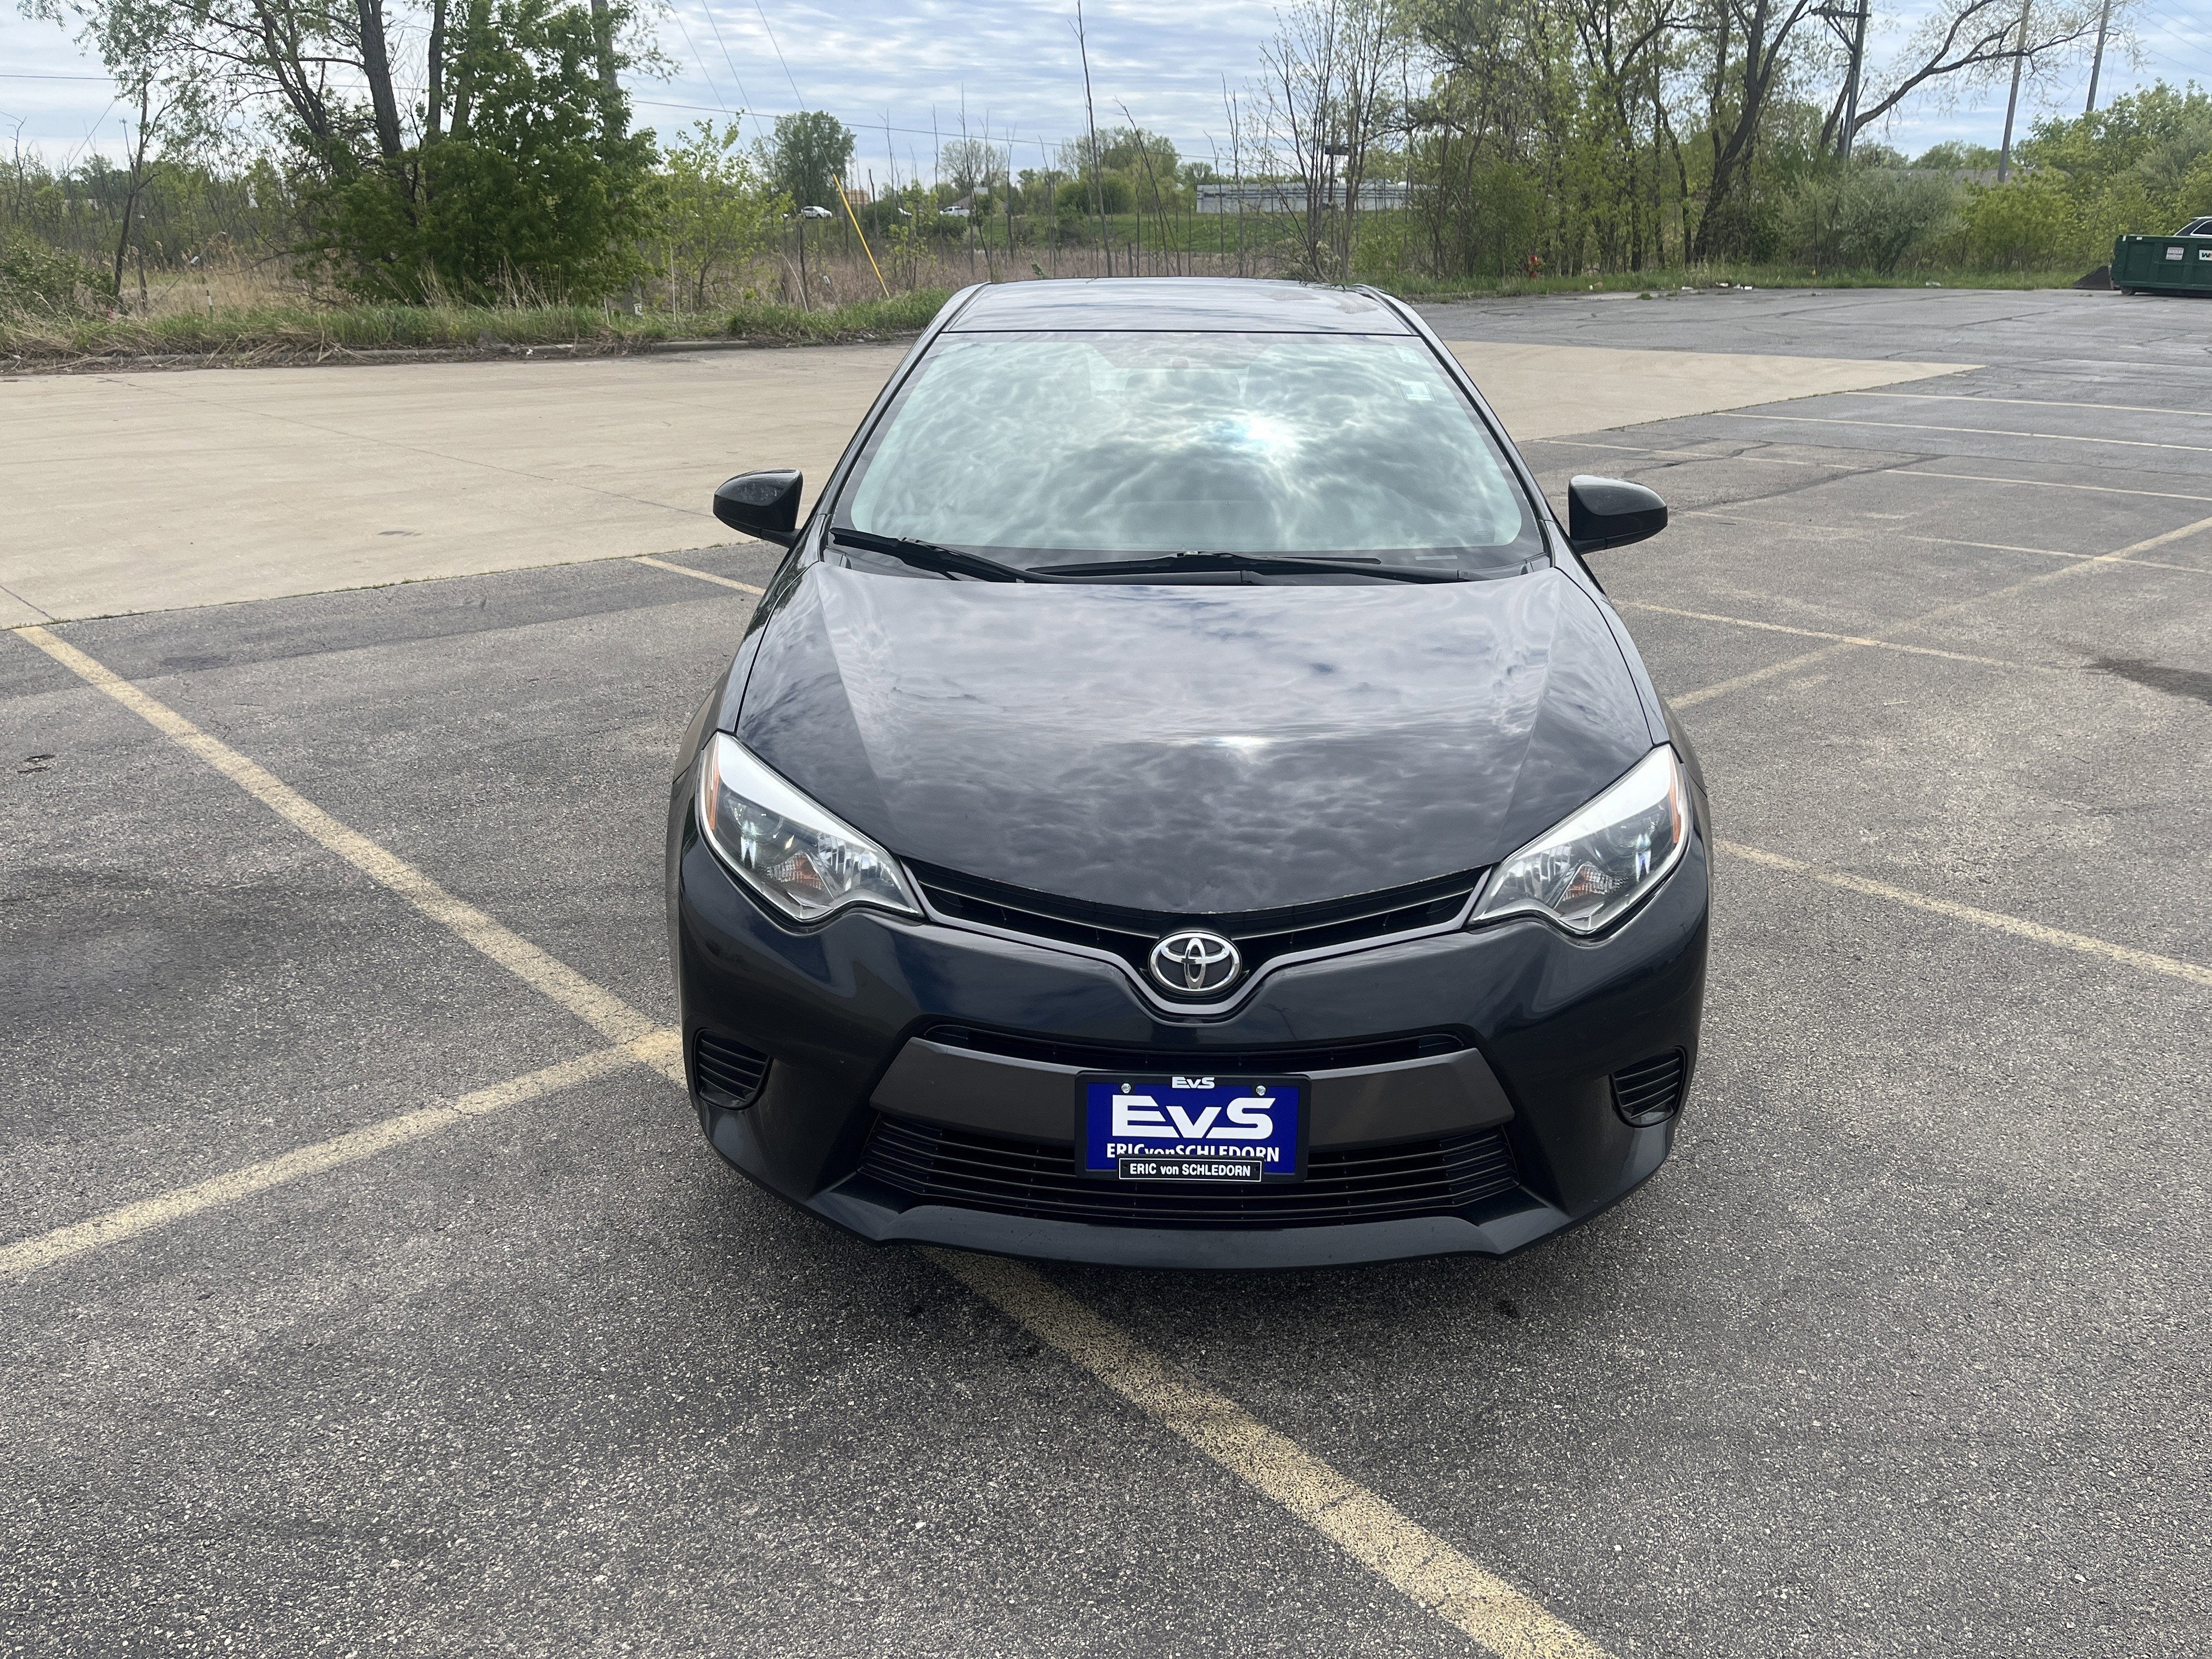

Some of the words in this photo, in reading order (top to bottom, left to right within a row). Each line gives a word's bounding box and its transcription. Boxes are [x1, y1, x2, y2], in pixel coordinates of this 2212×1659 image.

[1130, 1163, 1156, 1175] ERIC
[1160, 1165, 1179, 1175] von
[1182, 1164, 1251, 1176] SCHLEDORN
